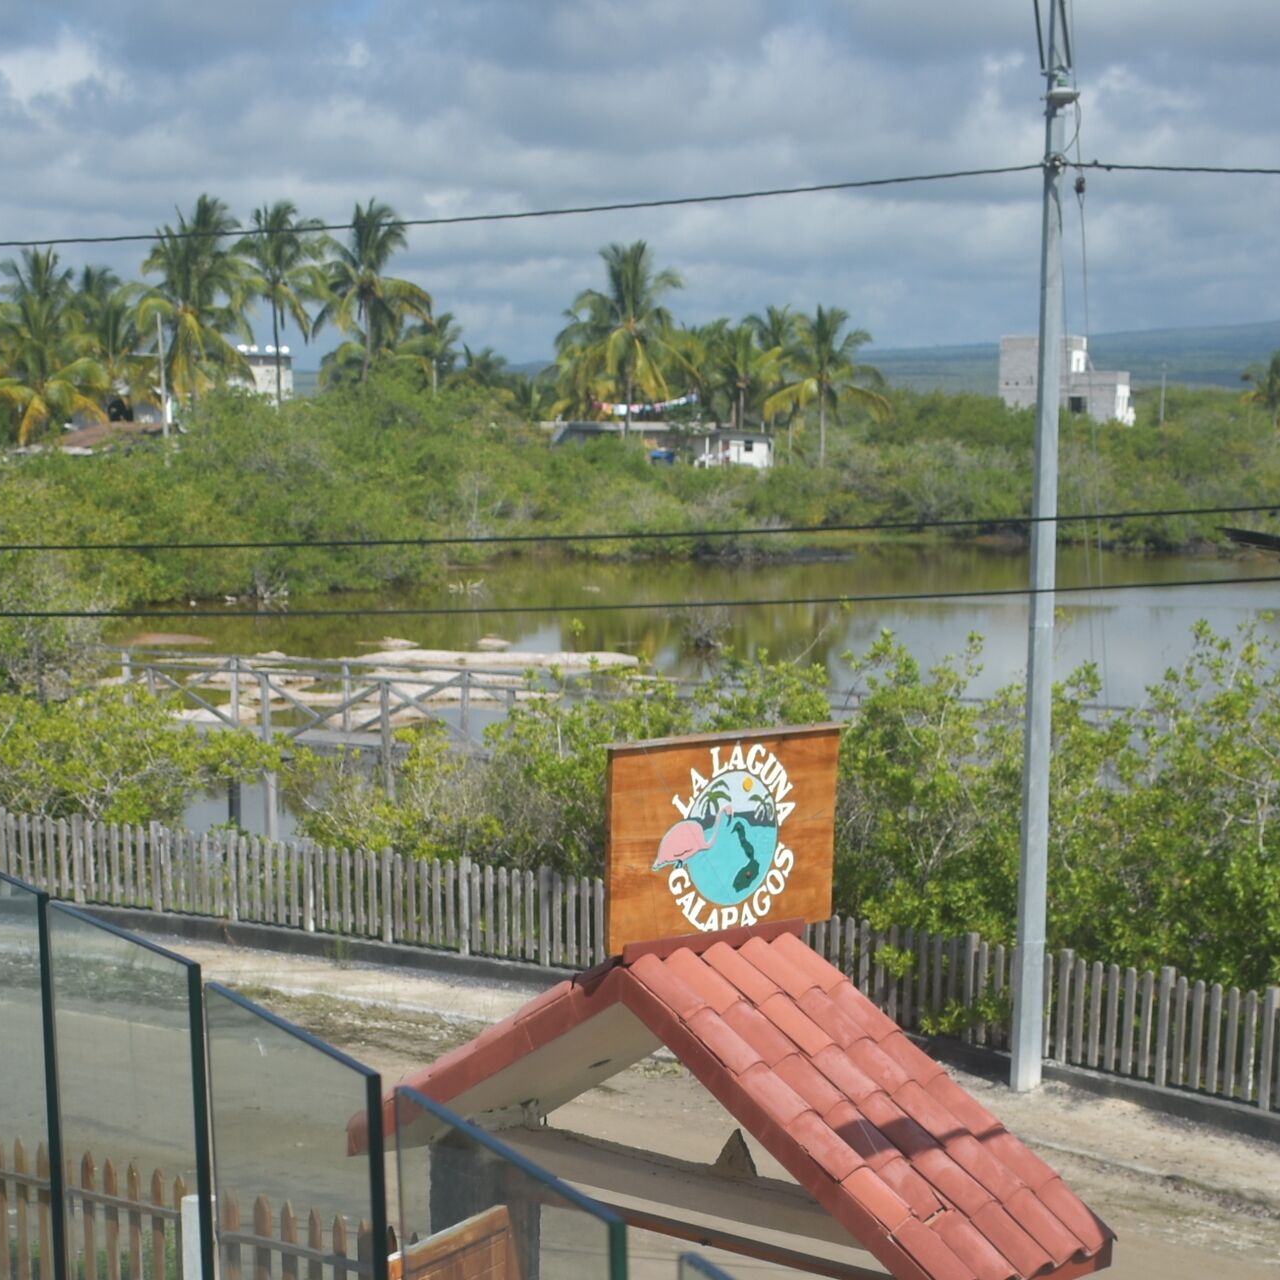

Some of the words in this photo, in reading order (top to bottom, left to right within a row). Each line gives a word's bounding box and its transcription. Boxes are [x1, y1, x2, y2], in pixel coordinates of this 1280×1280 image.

[672, 768, 709, 819] LA
[710, 744, 795, 826] LAGUNA
[668, 842, 794, 932] GALAPAGOS
